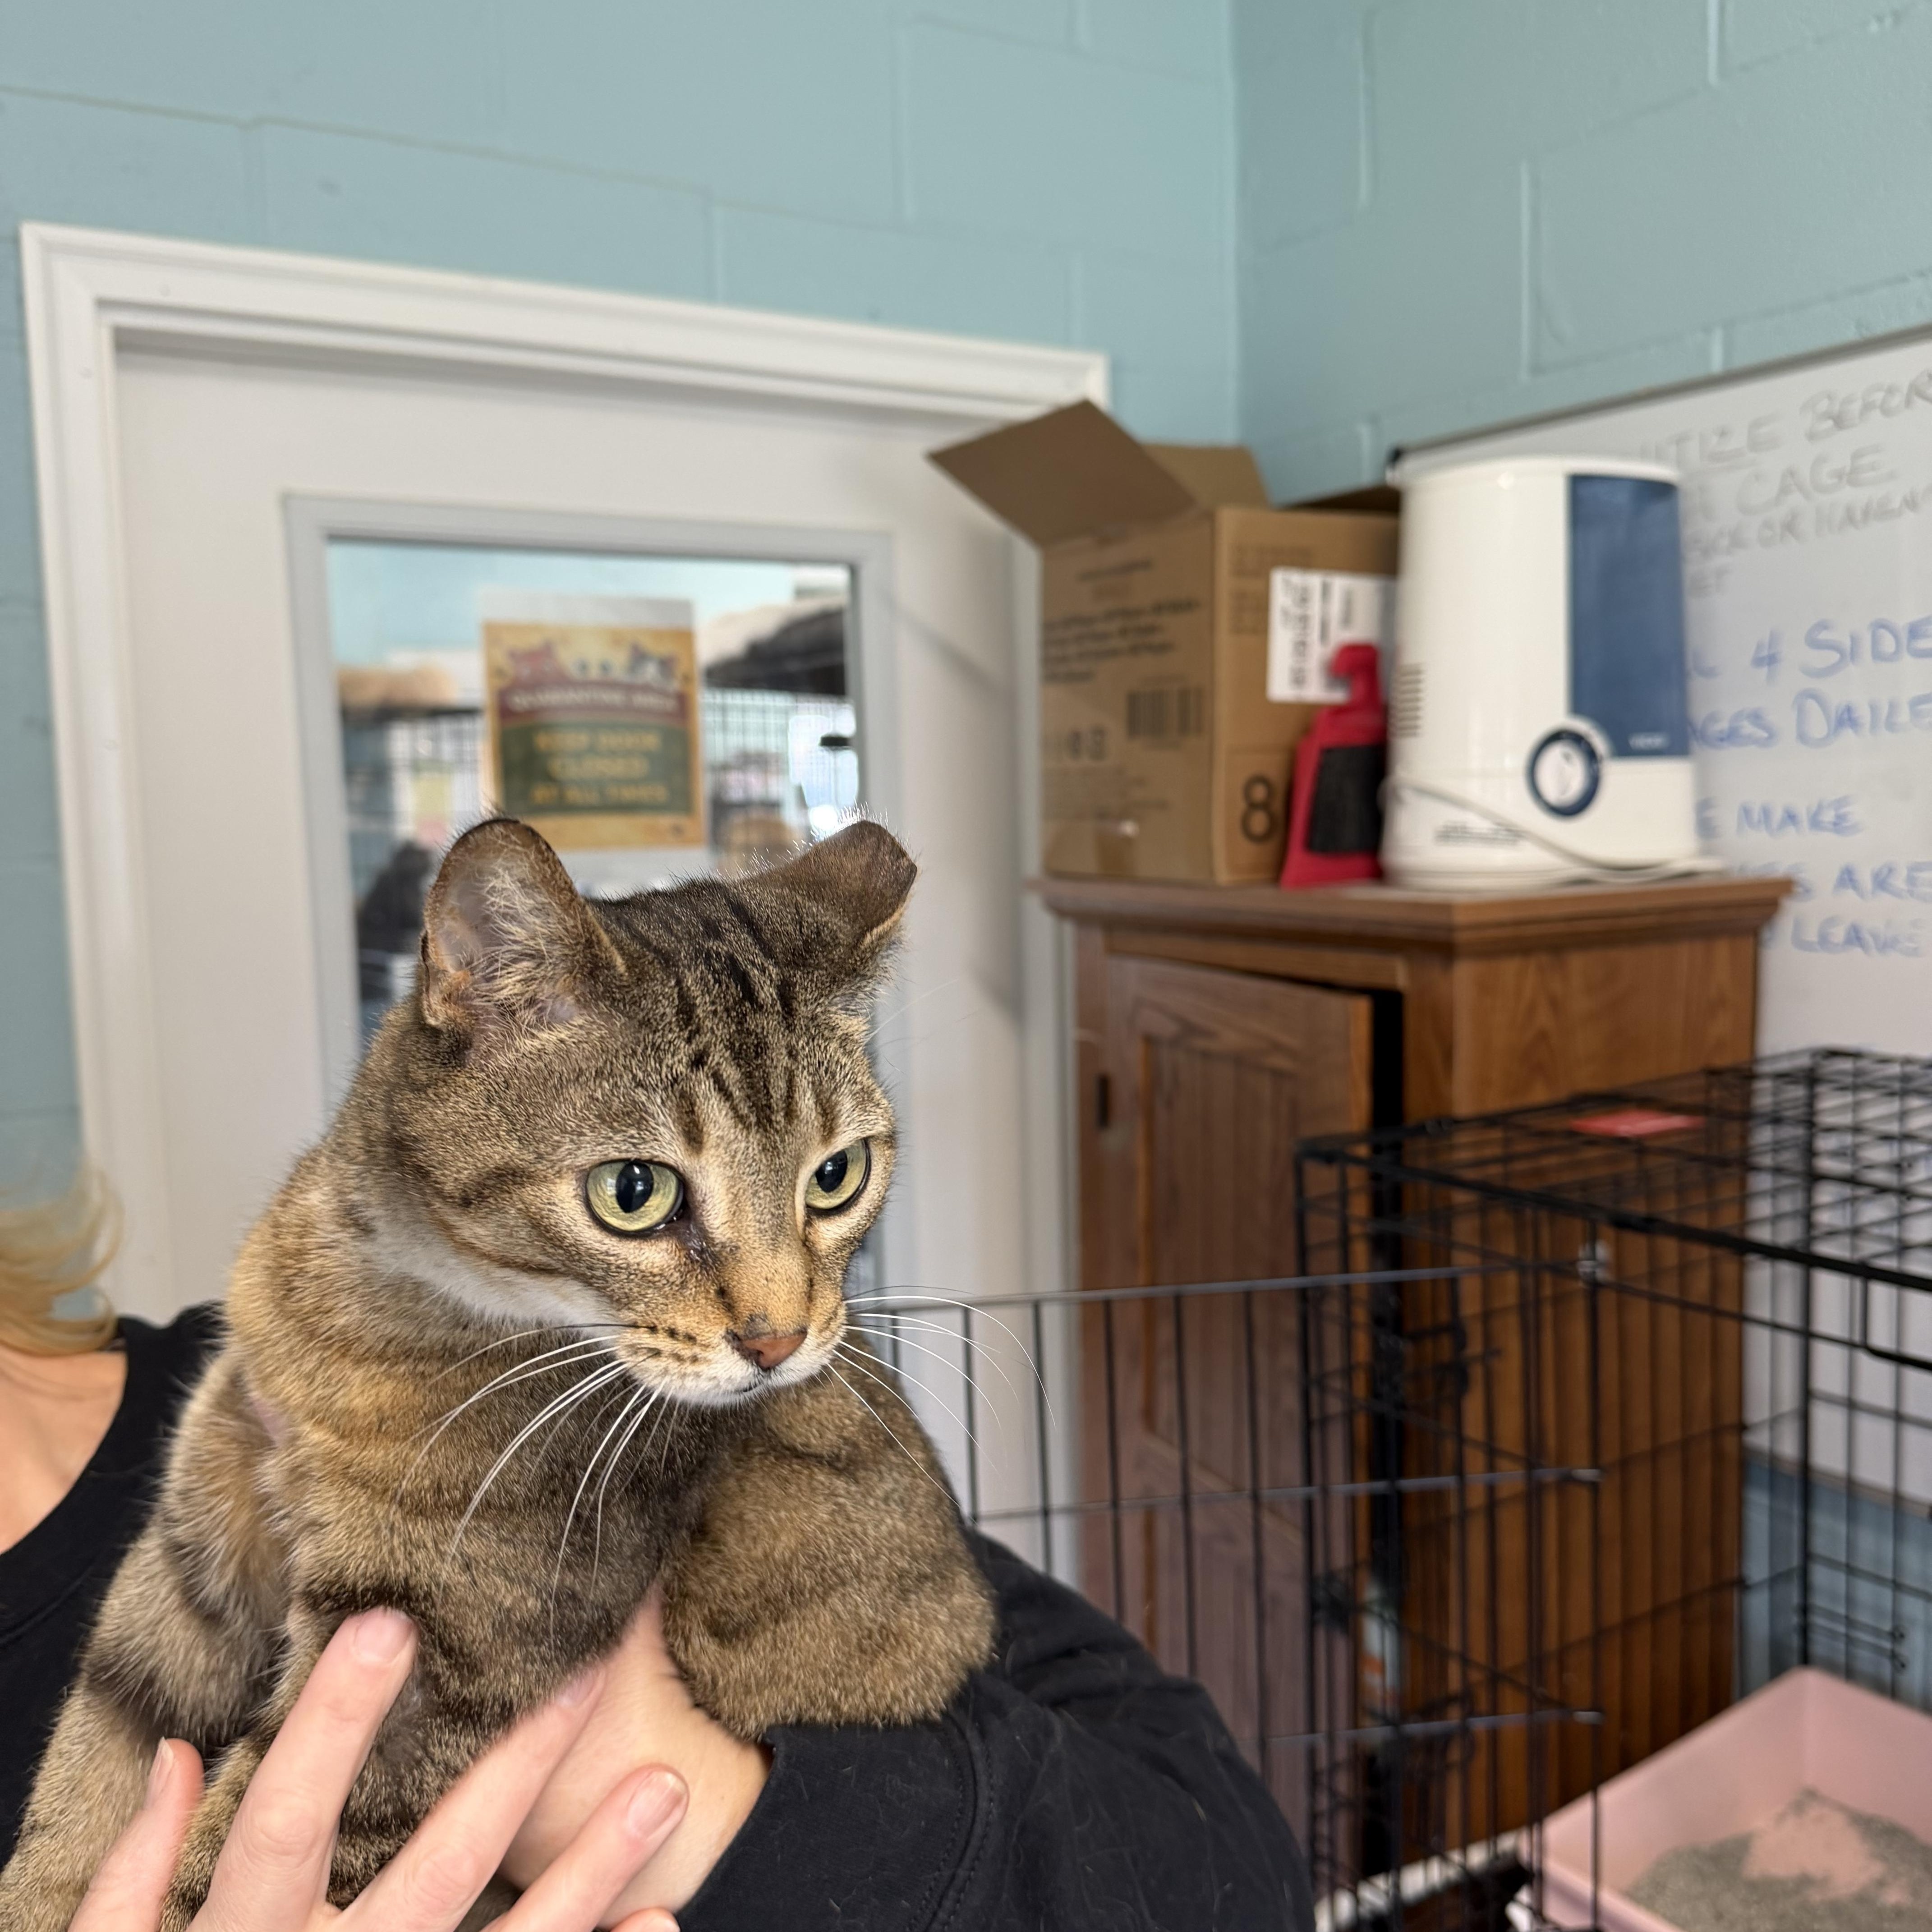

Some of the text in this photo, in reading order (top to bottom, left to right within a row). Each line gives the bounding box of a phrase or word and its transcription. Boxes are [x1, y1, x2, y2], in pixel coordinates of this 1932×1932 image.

[1736, 443, 1899, 515] CAGE
[1750, 627, 1784, 687] 4
[1240, 772, 1278, 845] 8
[1736, 795, 1863, 839] MAKE
[1832, 860, 1932, 903] ARE
[1790, 915, 1921, 958] LEAVE
